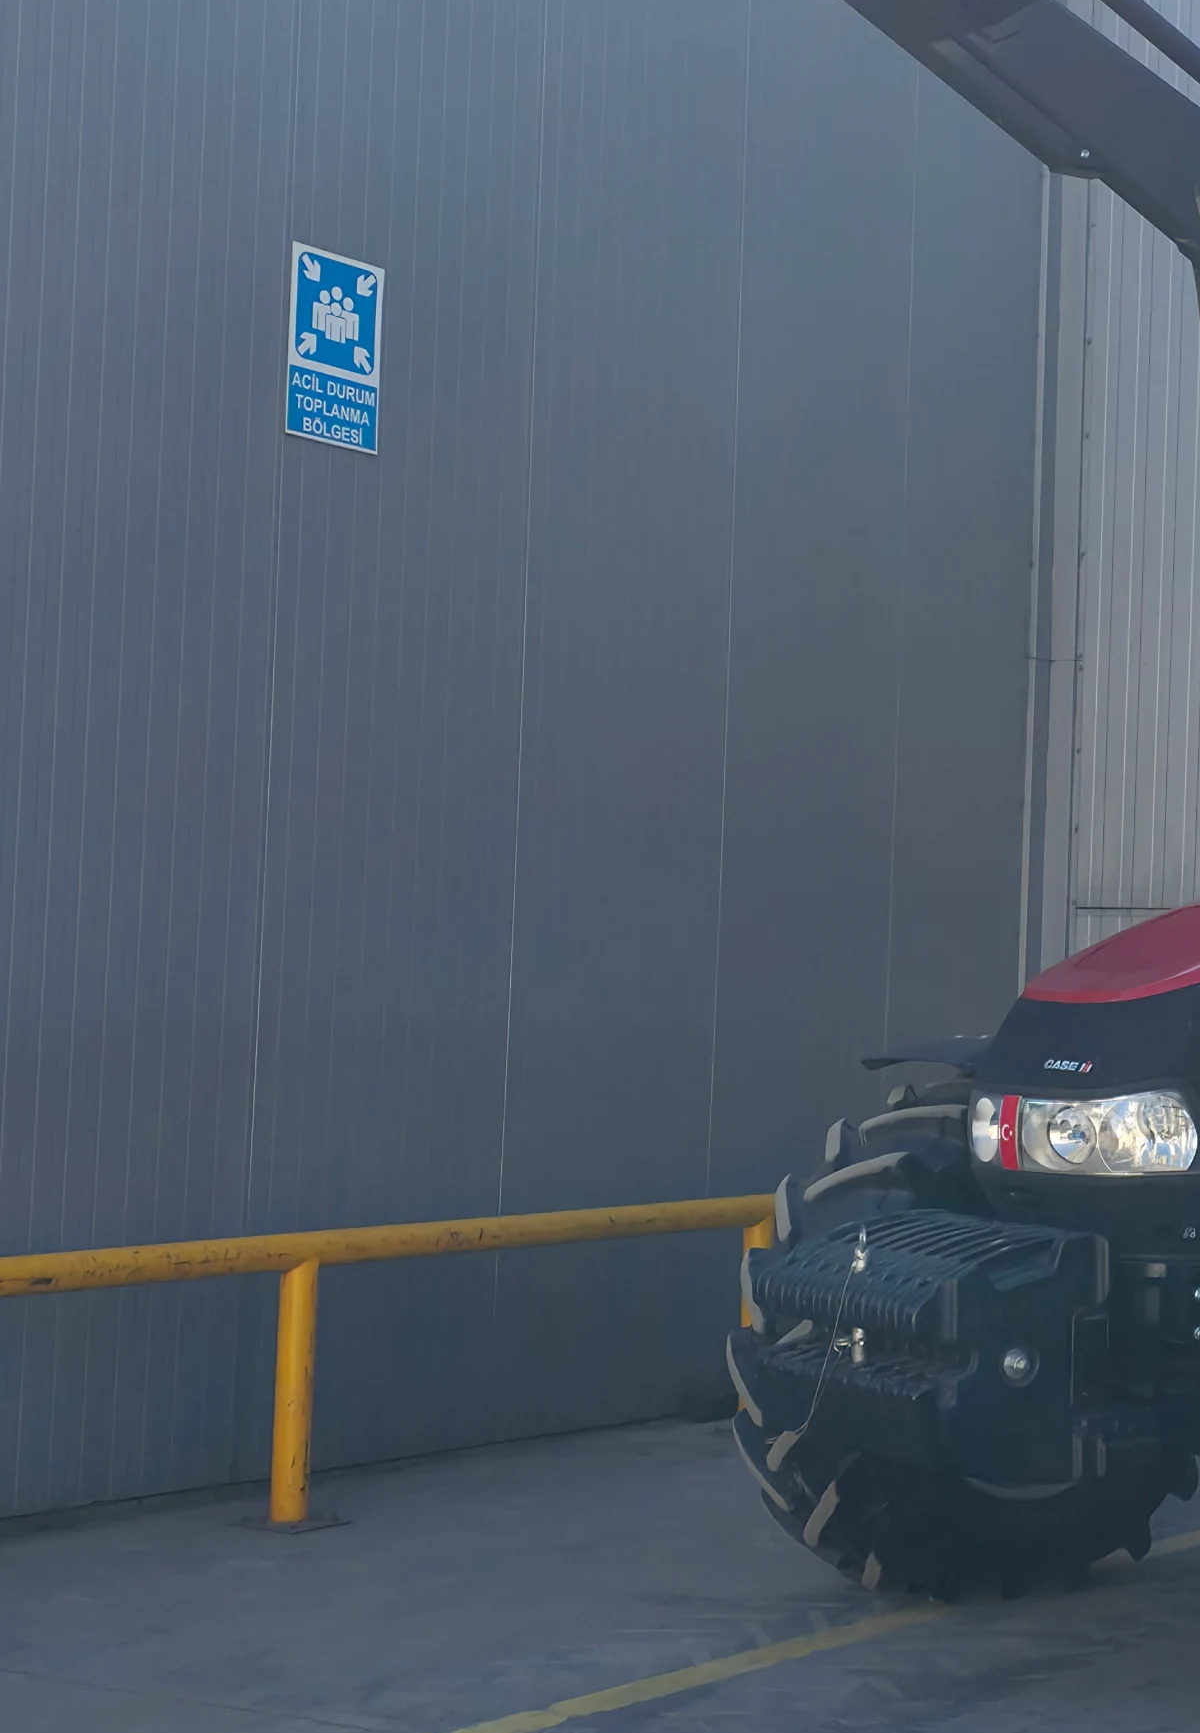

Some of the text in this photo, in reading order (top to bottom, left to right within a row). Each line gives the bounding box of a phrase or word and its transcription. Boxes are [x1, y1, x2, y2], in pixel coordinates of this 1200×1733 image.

[292, 371, 375, 407] ACİL DURUM
[295, 393, 370, 427] TOPLANMA
[303, 416, 363, 446] BÖLGESİ
[1043, 1059, 1079, 1071] CASE
